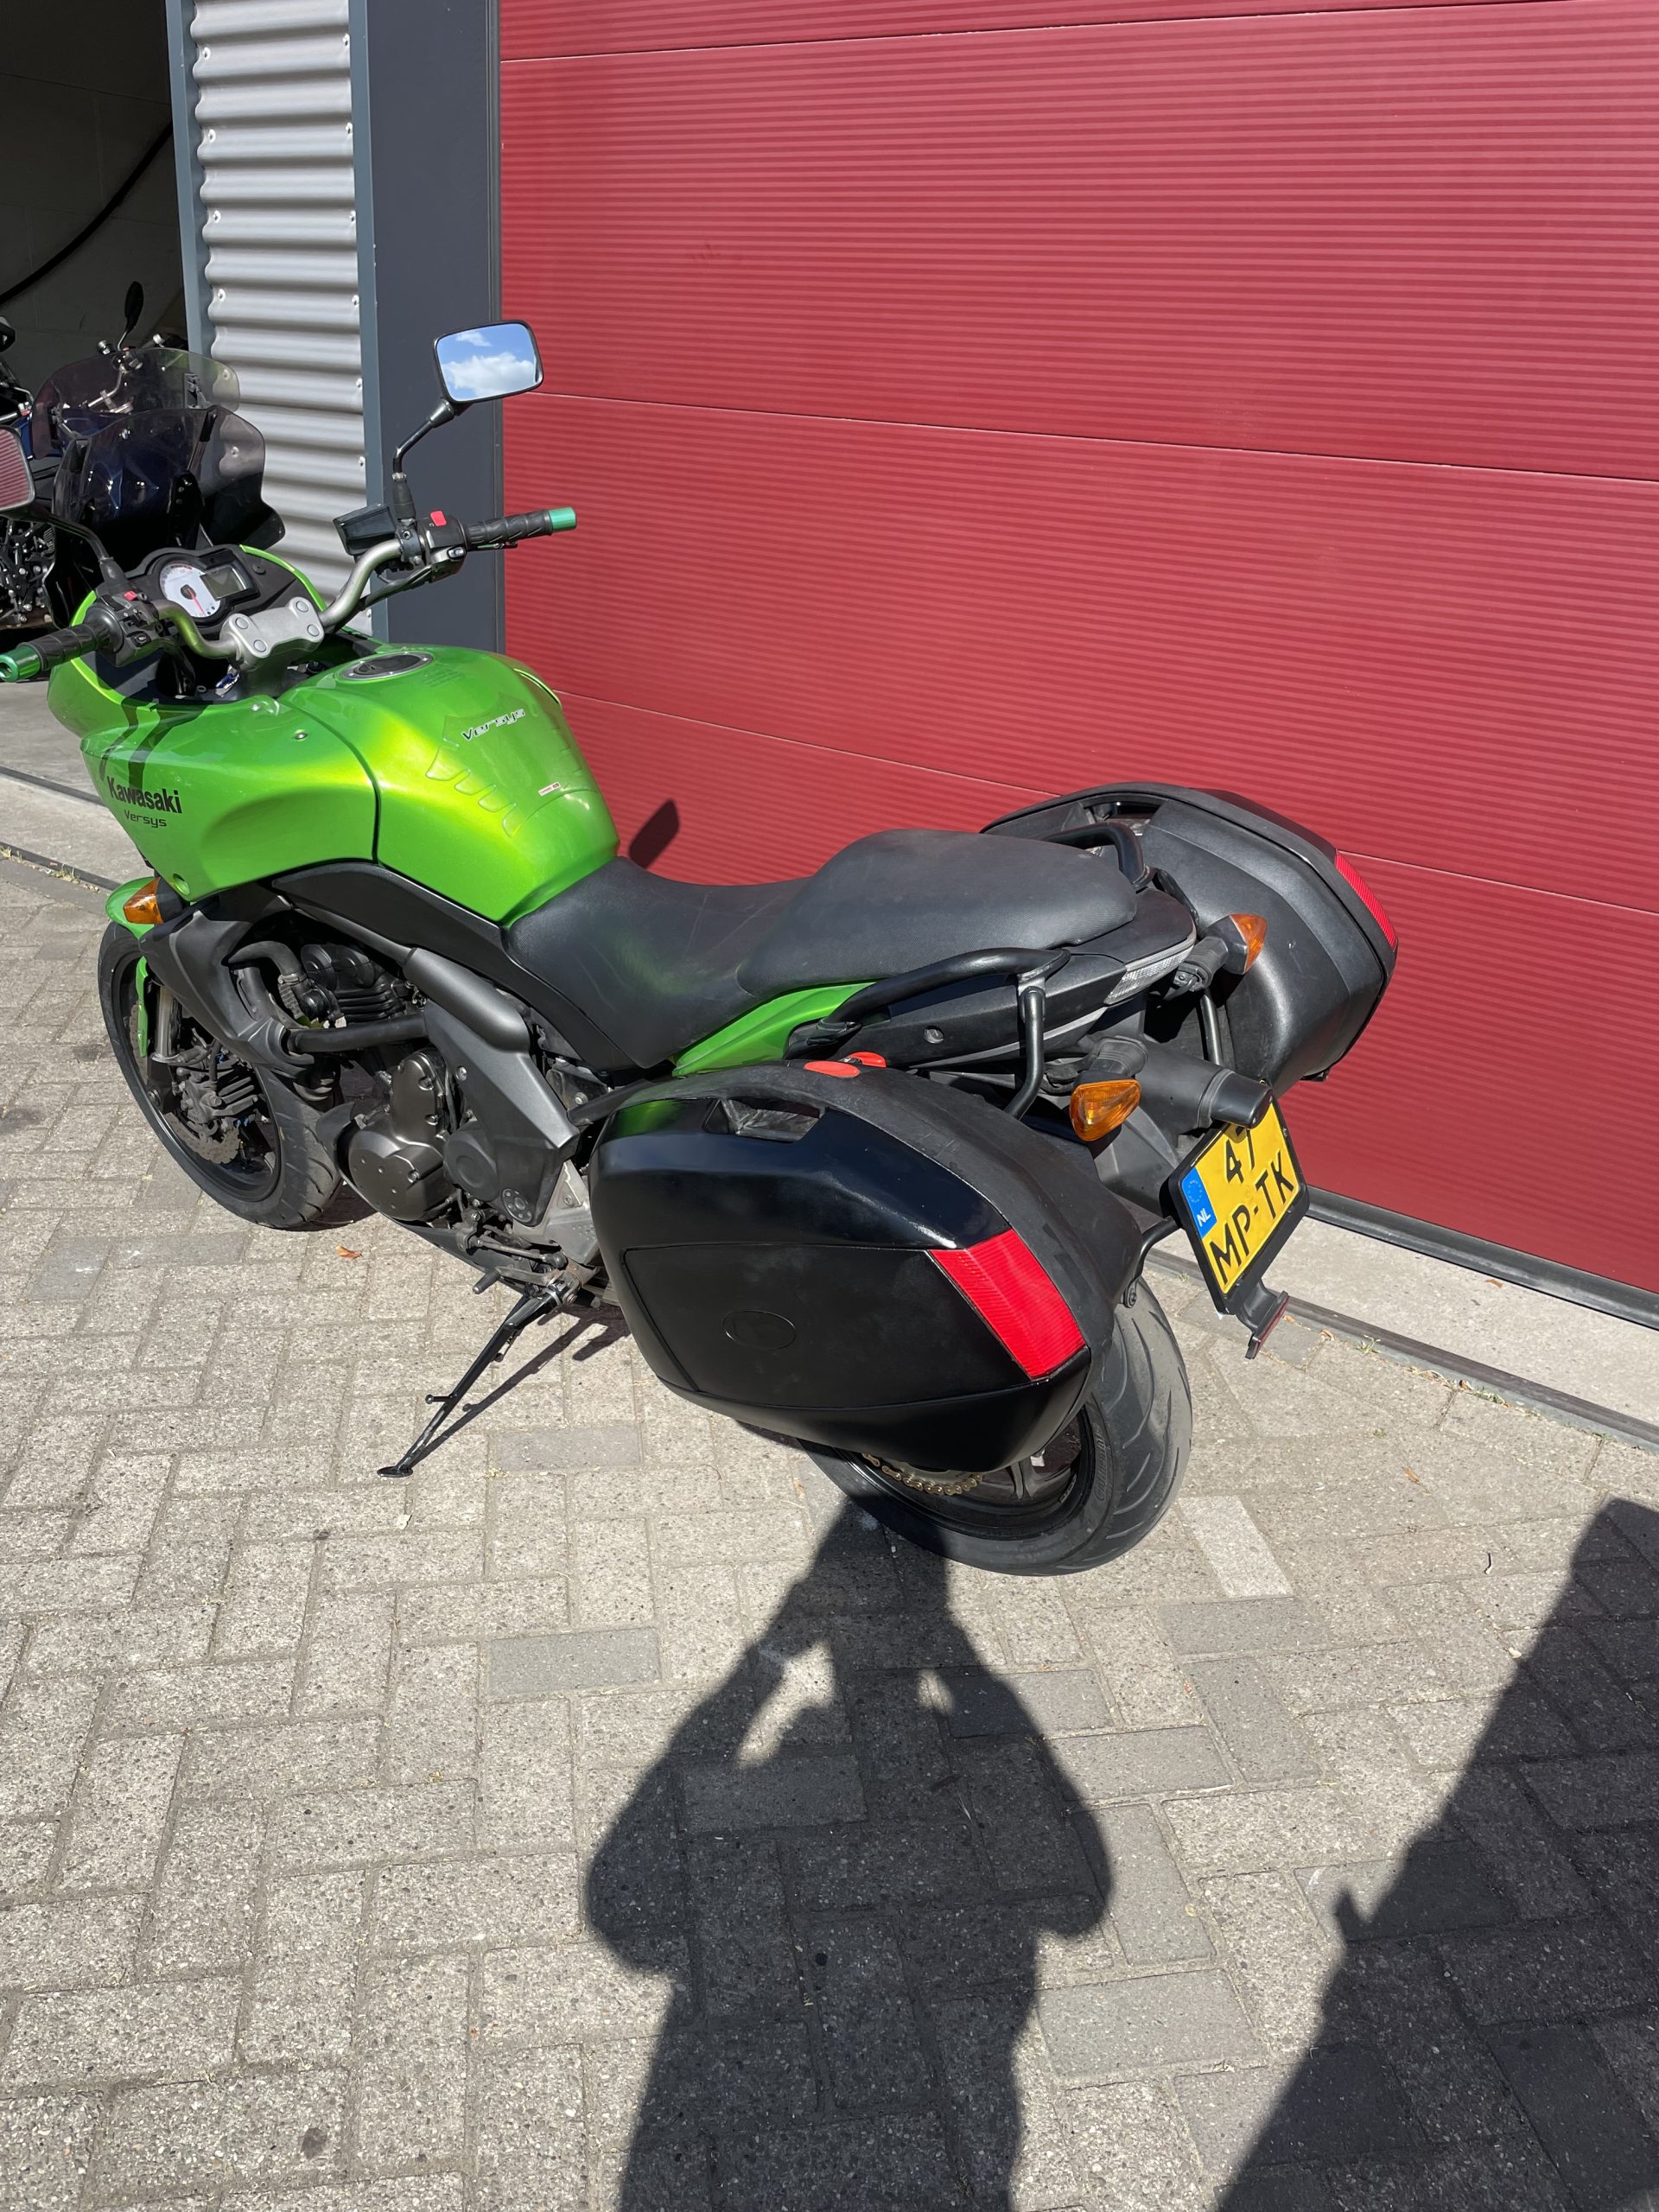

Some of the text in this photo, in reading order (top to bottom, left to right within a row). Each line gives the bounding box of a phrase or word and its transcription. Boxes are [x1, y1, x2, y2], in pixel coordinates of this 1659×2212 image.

[461, 709, 526, 741] Versys
[106, 776, 183, 814] Kawasaki
[124, 809, 168, 829] Versys
[1196, 1207, 1212, 1228] NL
[1209, 1152, 1295, 1284] MP-TK
